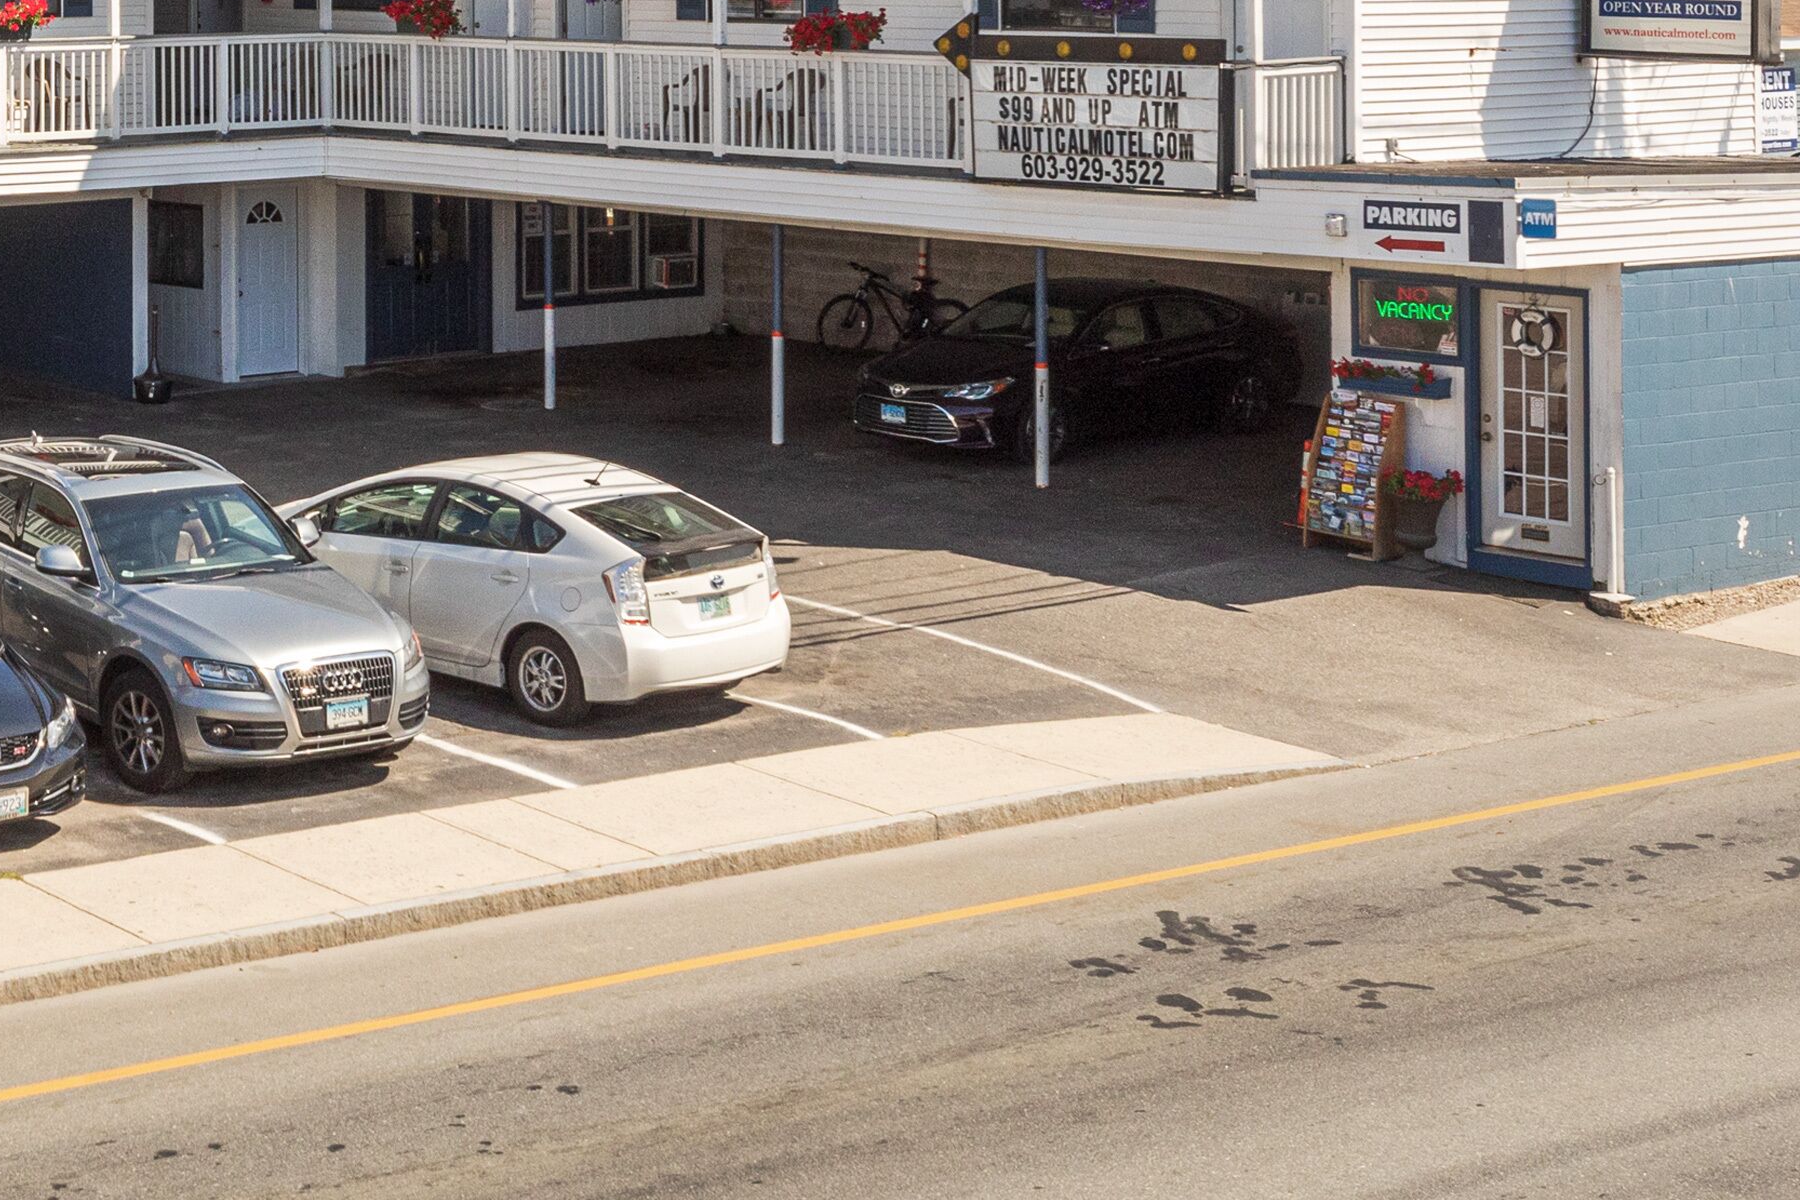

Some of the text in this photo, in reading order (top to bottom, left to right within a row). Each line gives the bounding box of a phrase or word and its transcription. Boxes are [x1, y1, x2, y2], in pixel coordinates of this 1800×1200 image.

[1603, 0, 1738, 17] OPEN YEAR ROUND
[1604, 26, 1736, 40] www.nauticalmotel.com
[993, 66, 1187, 98] MID-WEEK SPECIAL
[1040, 98, 1075, 124] AND
[1088, 99, 1112, 125] UP
[1139, 101, 1179, 128] ATM
[998, 125, 1194, 161] NAUTICALMOTEL.COM
[1022, 154, 1165, 186] 603-929-3522
[1366, 206, 1457, 228] PARKING
[1524, 212, 1554, 226] ATM
[1397, 287, 1429, 302] NO
[1375, 300, 1453, 321] VACANCY
